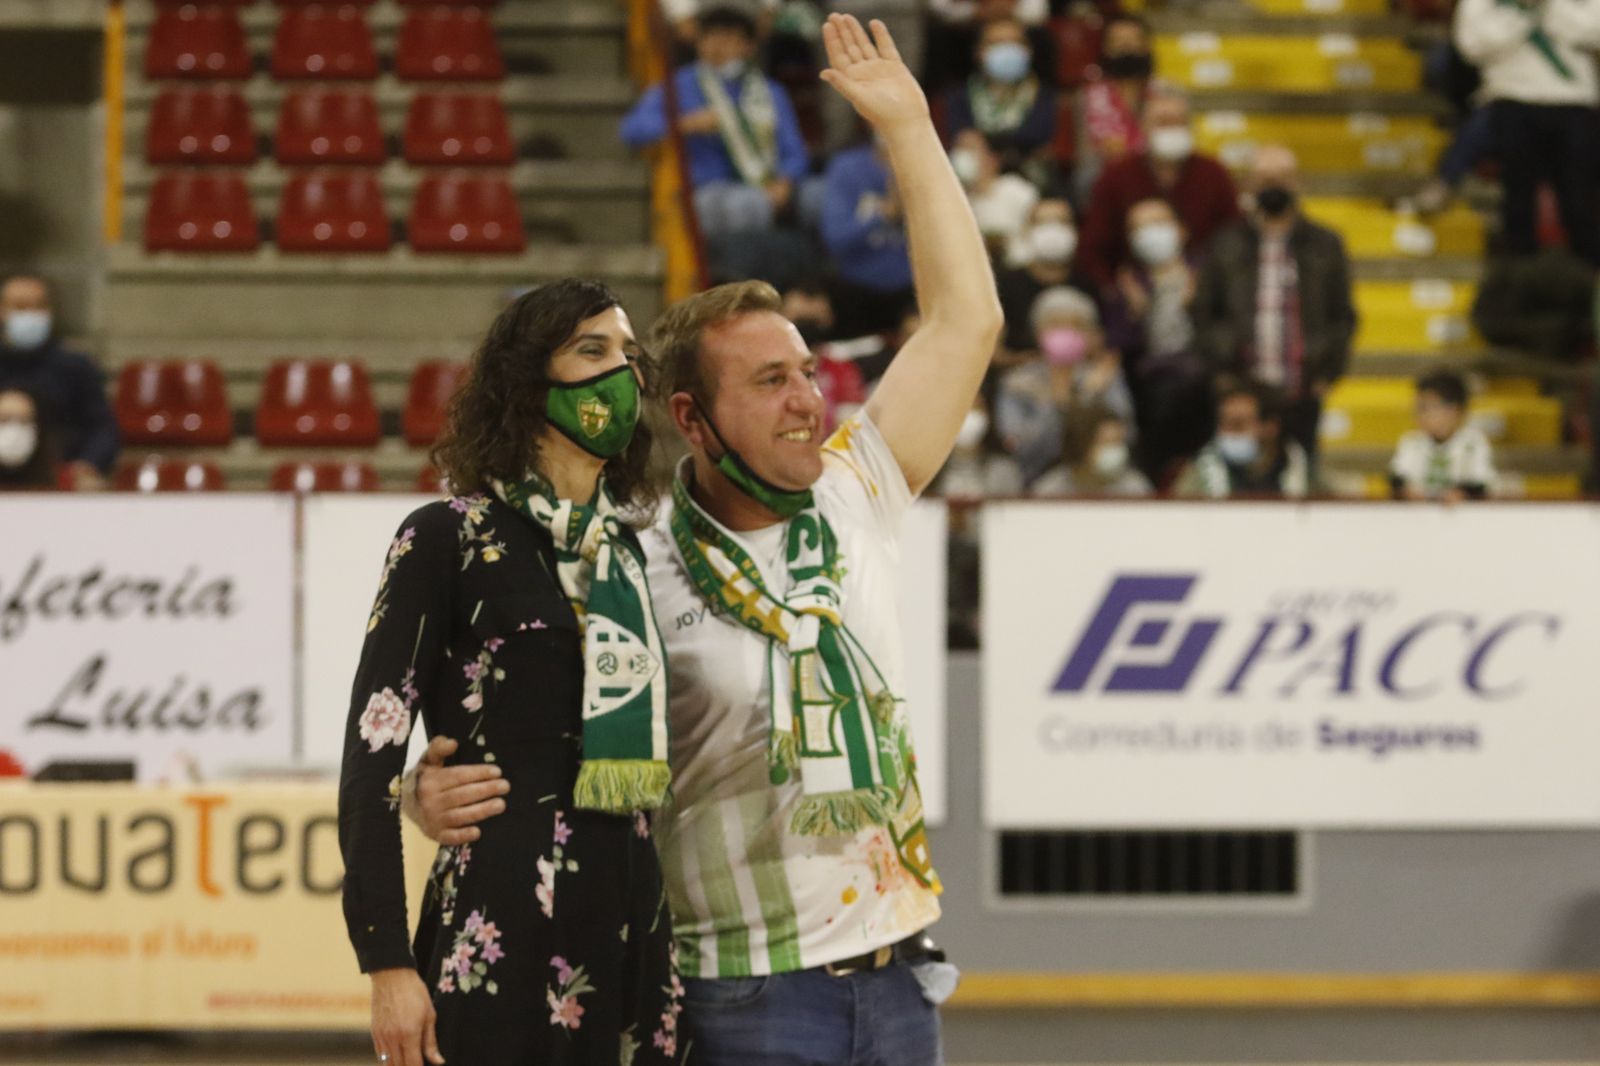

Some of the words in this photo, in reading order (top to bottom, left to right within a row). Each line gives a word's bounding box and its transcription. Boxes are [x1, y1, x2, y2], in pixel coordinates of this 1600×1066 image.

[24, 652, 268, 732] Luisa
[1219, 609, 1561, 701] PACC
[1316, 718, 1481, 763] Seguros
